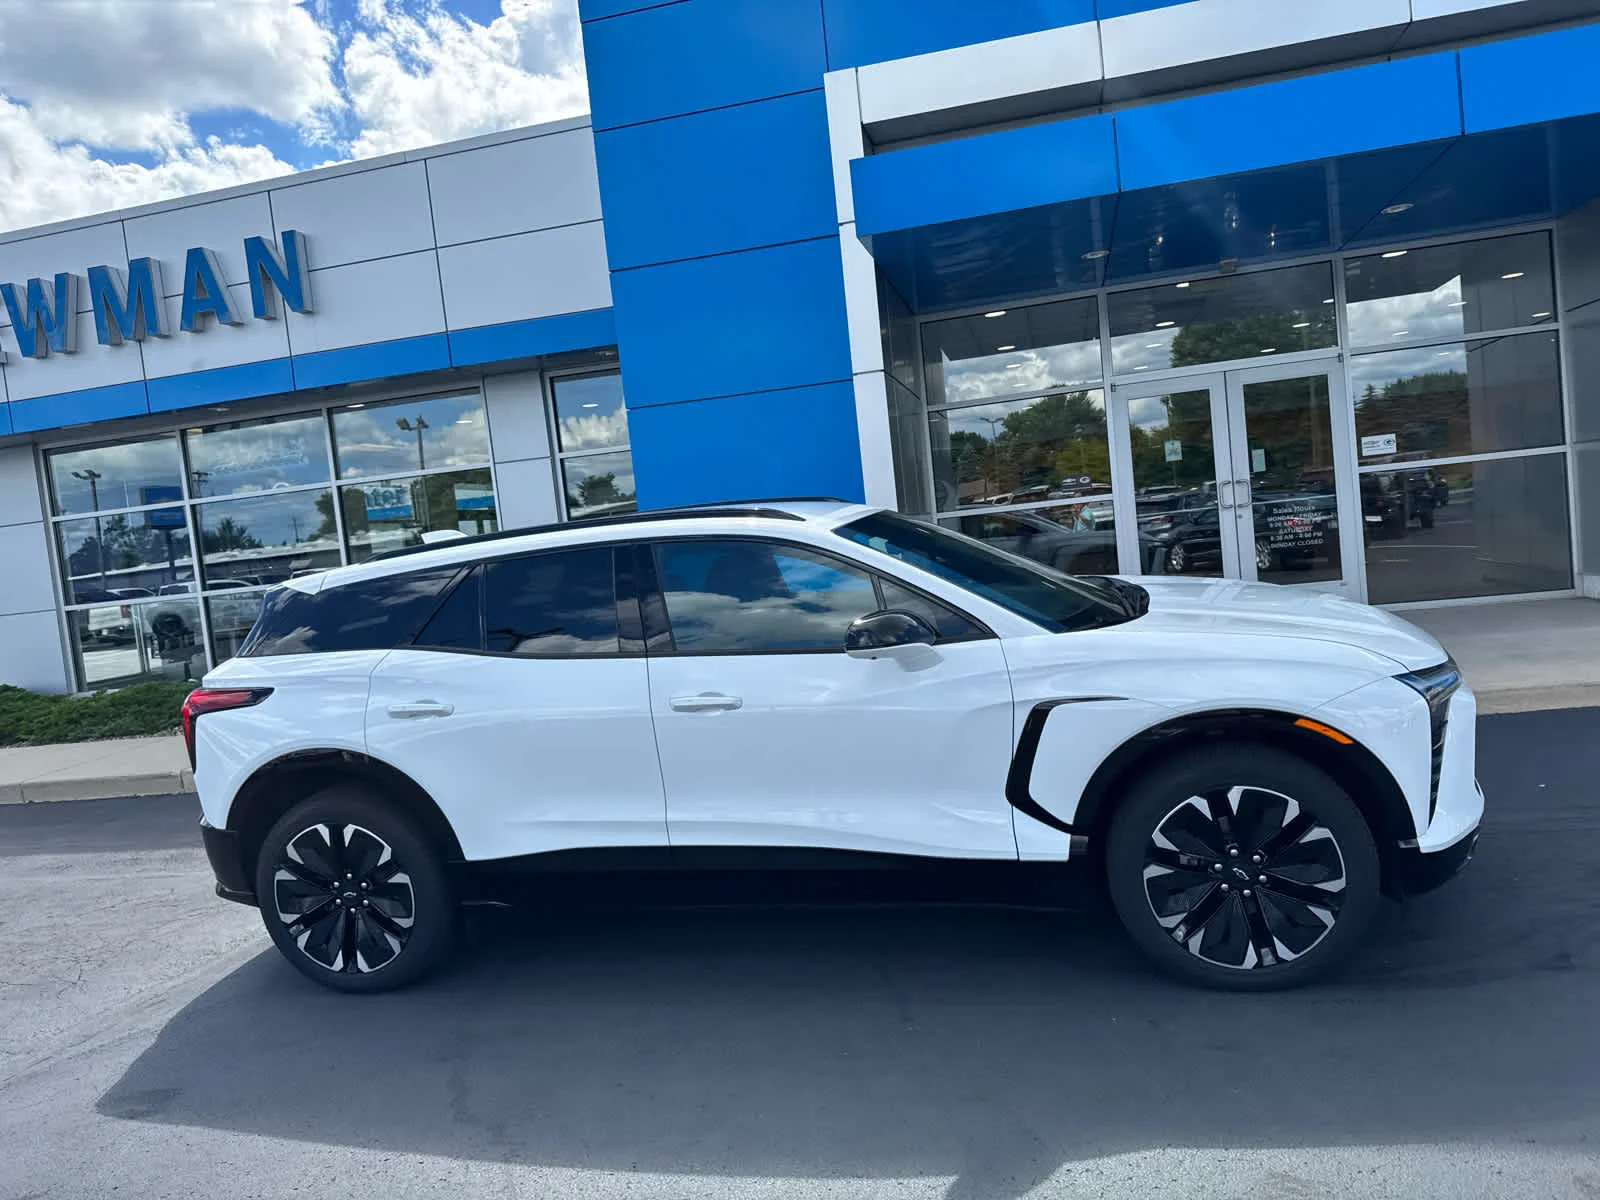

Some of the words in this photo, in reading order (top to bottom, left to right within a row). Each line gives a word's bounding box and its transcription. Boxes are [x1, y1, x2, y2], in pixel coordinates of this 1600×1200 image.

[0, 229, 312, 361] WMAN
[1270, 541, 1296, 549] SUNDAY
[1297, 538, 1324, 546] CLOSED
